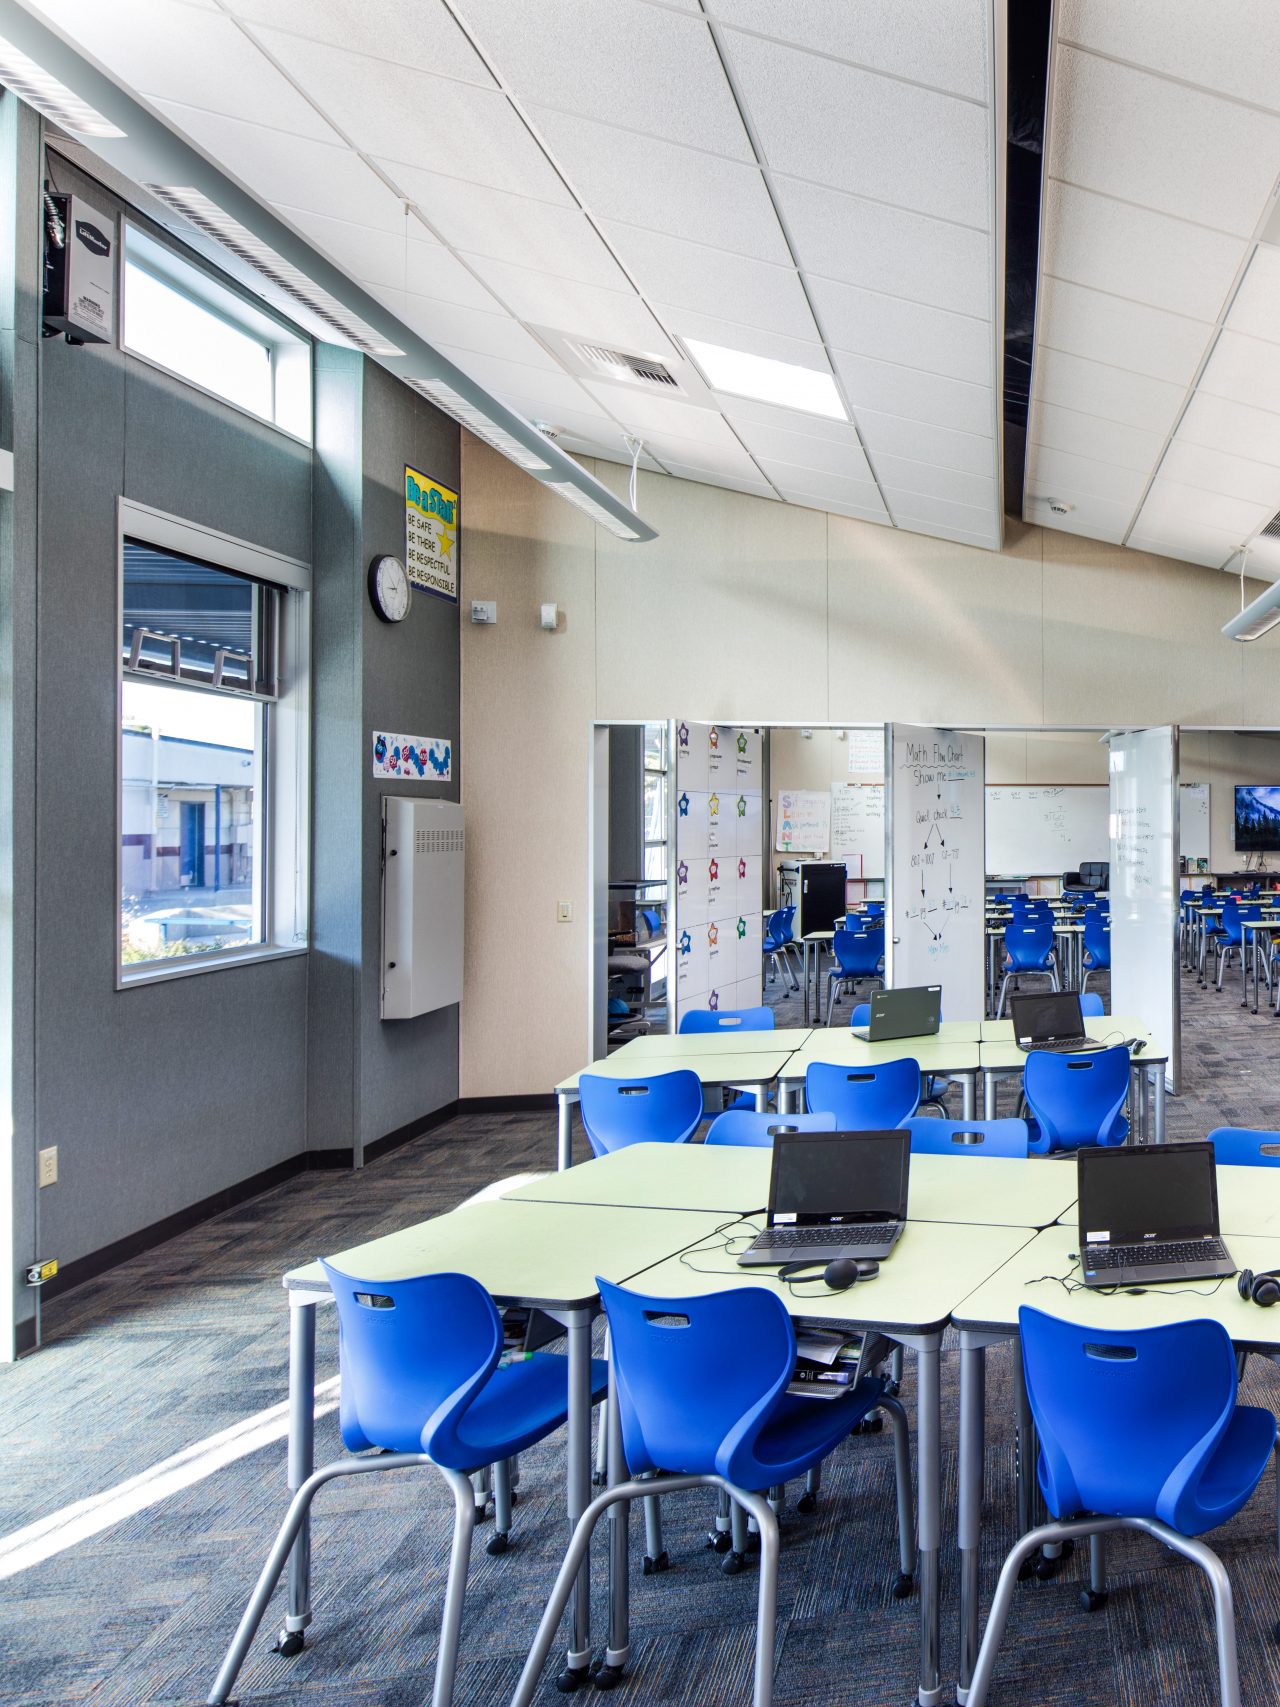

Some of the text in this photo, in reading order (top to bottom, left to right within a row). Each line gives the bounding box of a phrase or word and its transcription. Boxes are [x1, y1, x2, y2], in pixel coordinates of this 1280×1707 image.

[408, 513, 432, 535] BE SAFE
[408, 530, 436, 553] BE THERE
[408, 547, 451, 576] BE RESPECTFUL
[408, 565, 455, 594] BE RESPONSIBLE
[906, 742, 927, 762] Math
[948, 744, 964, 762] Chart
[913, 769, 934, 787] Show
